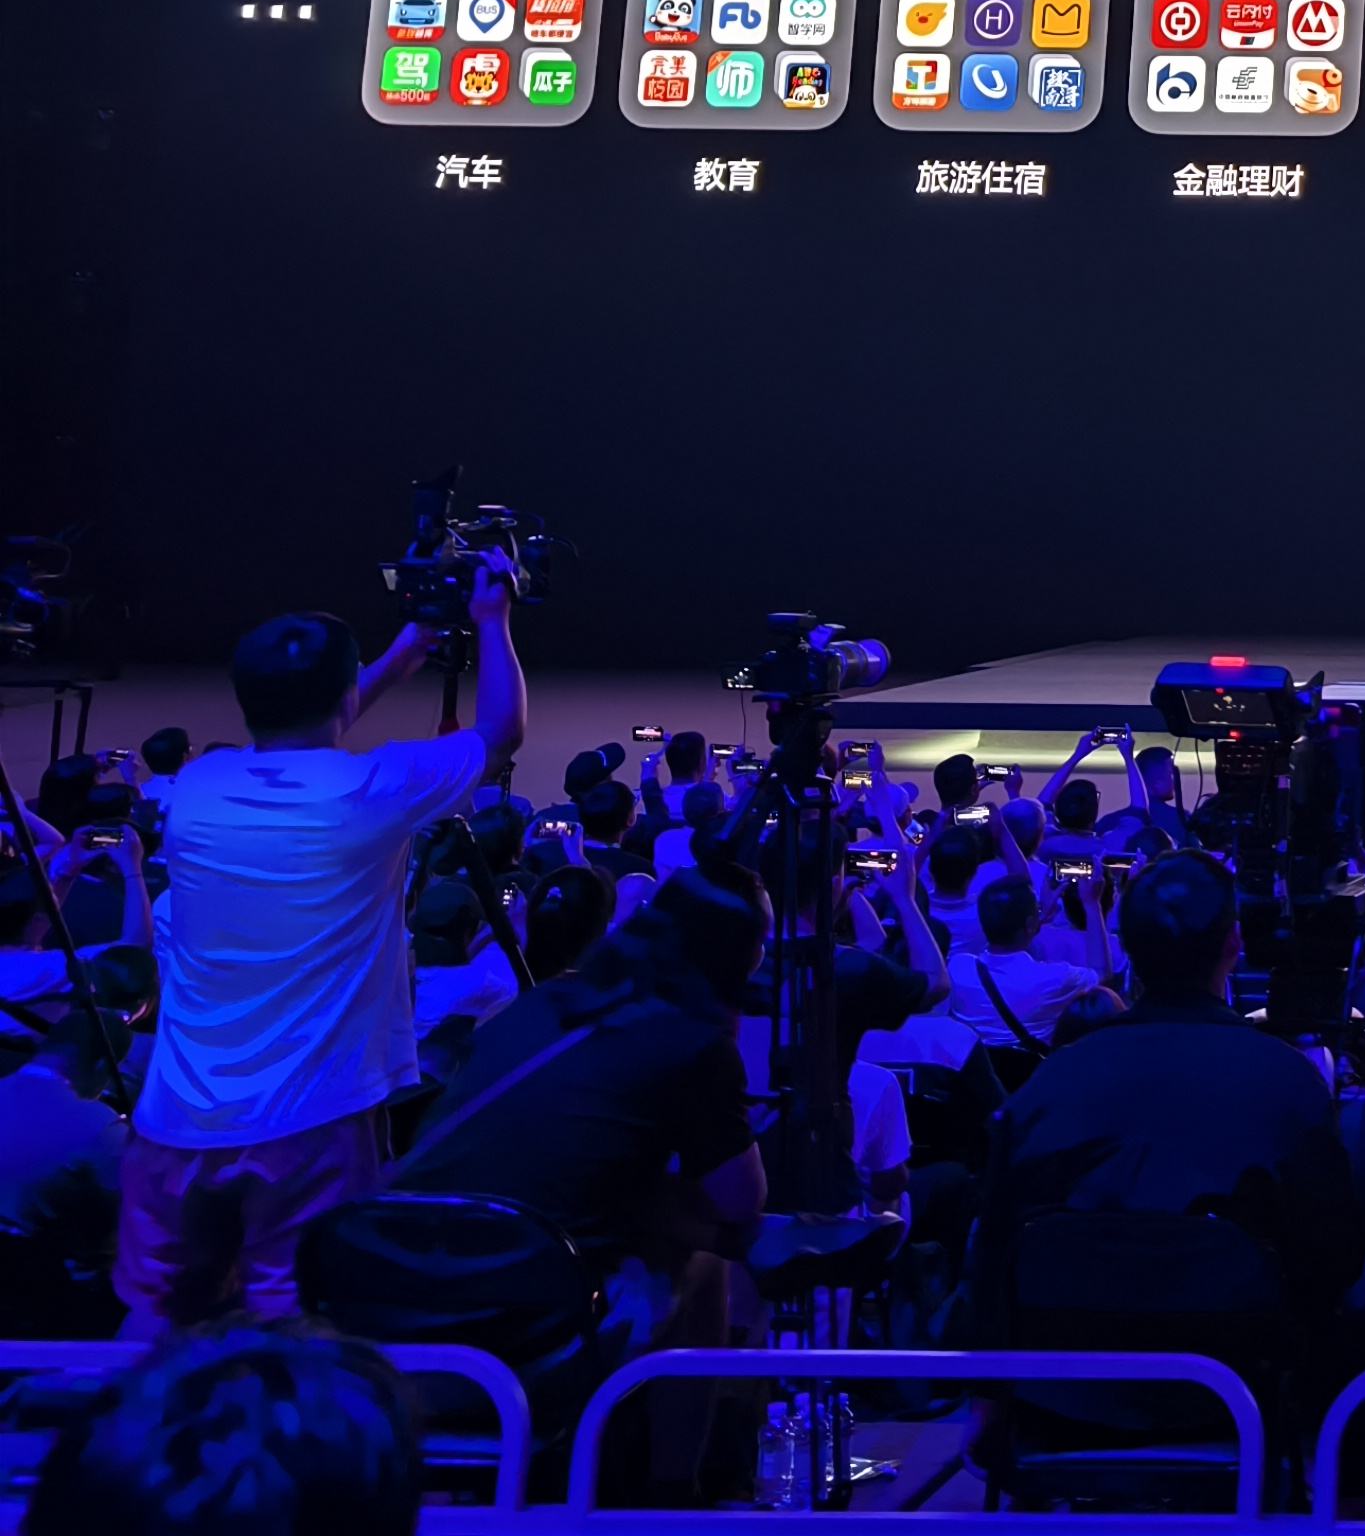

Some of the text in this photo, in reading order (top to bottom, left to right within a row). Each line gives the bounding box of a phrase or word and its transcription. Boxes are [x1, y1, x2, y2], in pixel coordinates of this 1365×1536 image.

[476, 4, 498, 15] BUS
[788, 23, 826, 36] 智学网
[393, 52, 429, 87] 驾
[534, 71, 572, 92] 瓜子
[650, 55, 687, 76] 完美
[716, 60, 754, 100] 师
[648, 79, 684, 100] 校园
[435, 154, 503, 190] 汽车
[693, 158, 760, 192] 教育
[916, 160, 1046, 195] 旅游住宿
[1172, 163, 1304, 197] 金融理财
